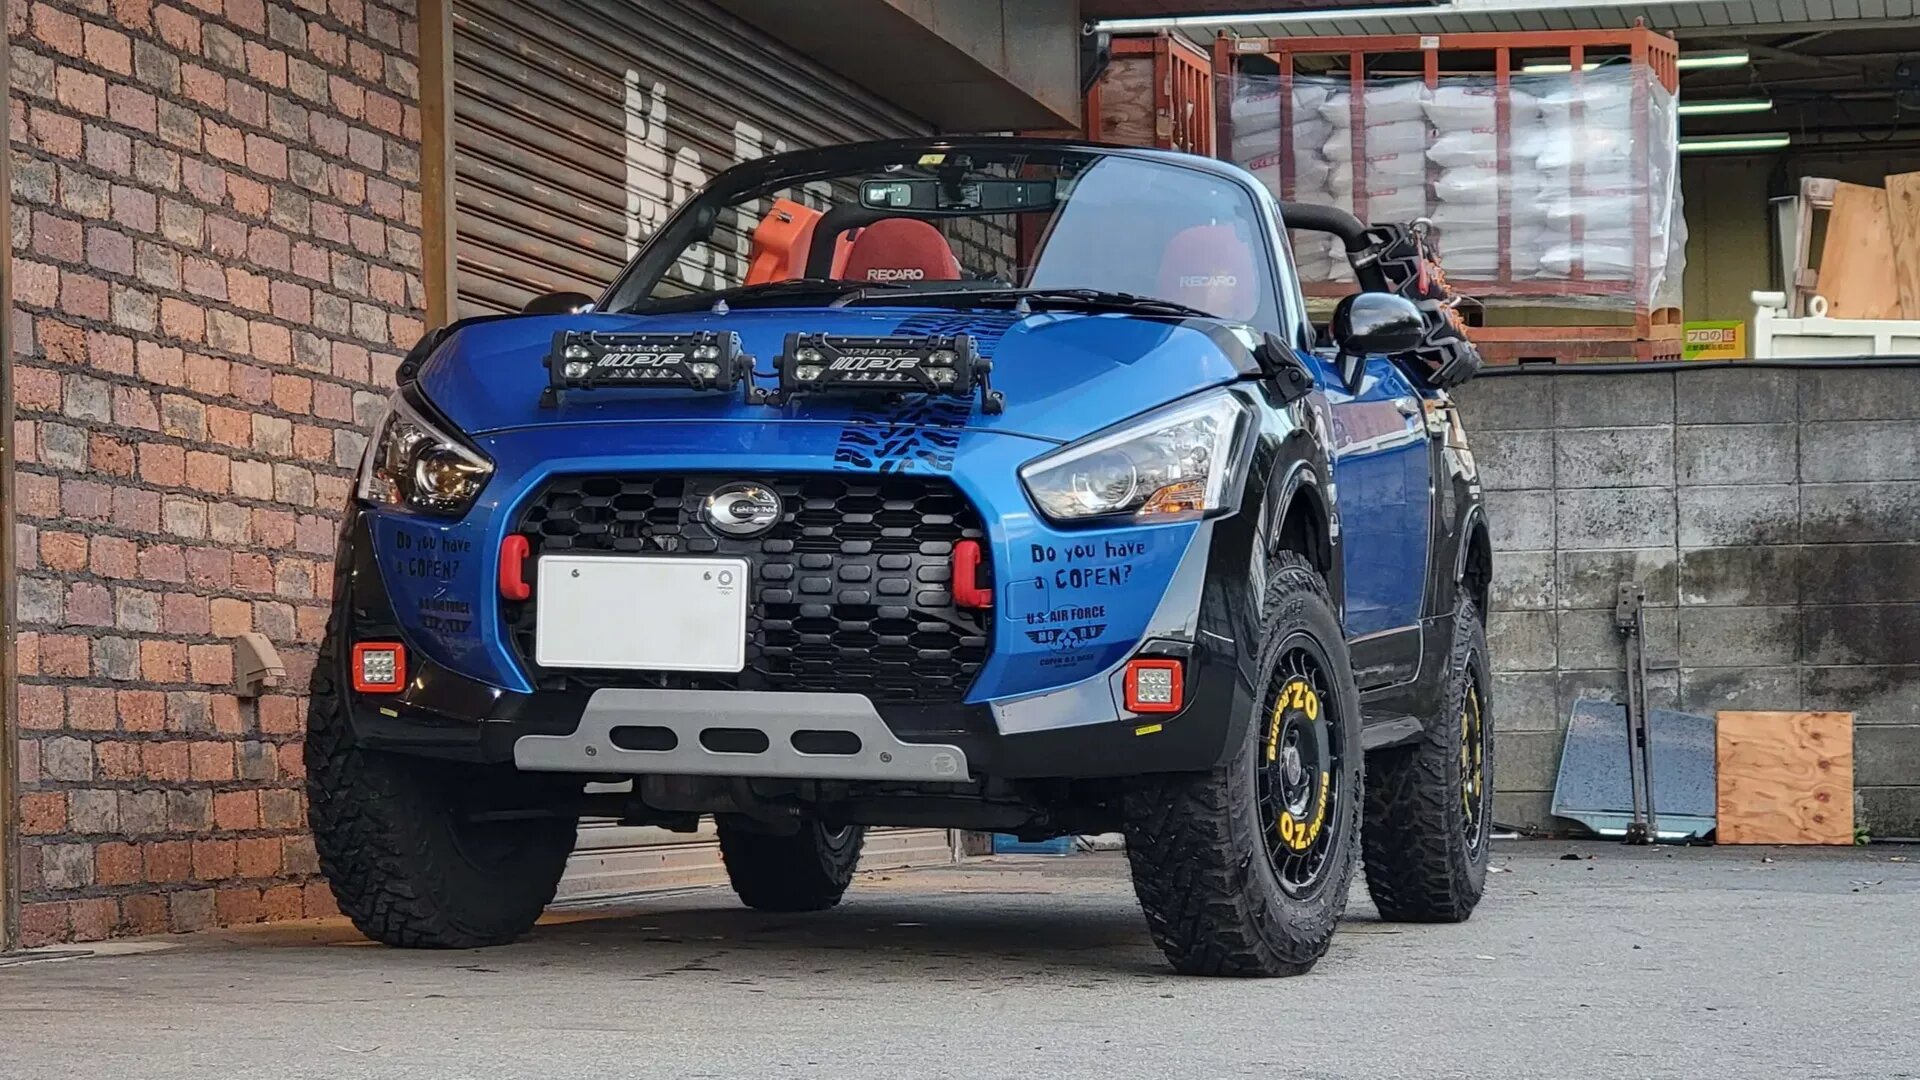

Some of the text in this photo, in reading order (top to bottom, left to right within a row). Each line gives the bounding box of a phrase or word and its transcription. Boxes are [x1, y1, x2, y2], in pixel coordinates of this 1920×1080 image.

[867, 269, 924, 280] RECARO
[1180, 276, 1236, 288] RECARO
[442, 537, 471, 552] have
[1031, 541, 1145, 563] Do you have
[1035, 565, 1132, 589] a COPEN?
[1050, 609, 1068, 622] AIR
[1071, 606, 1105, 620] FORCE
